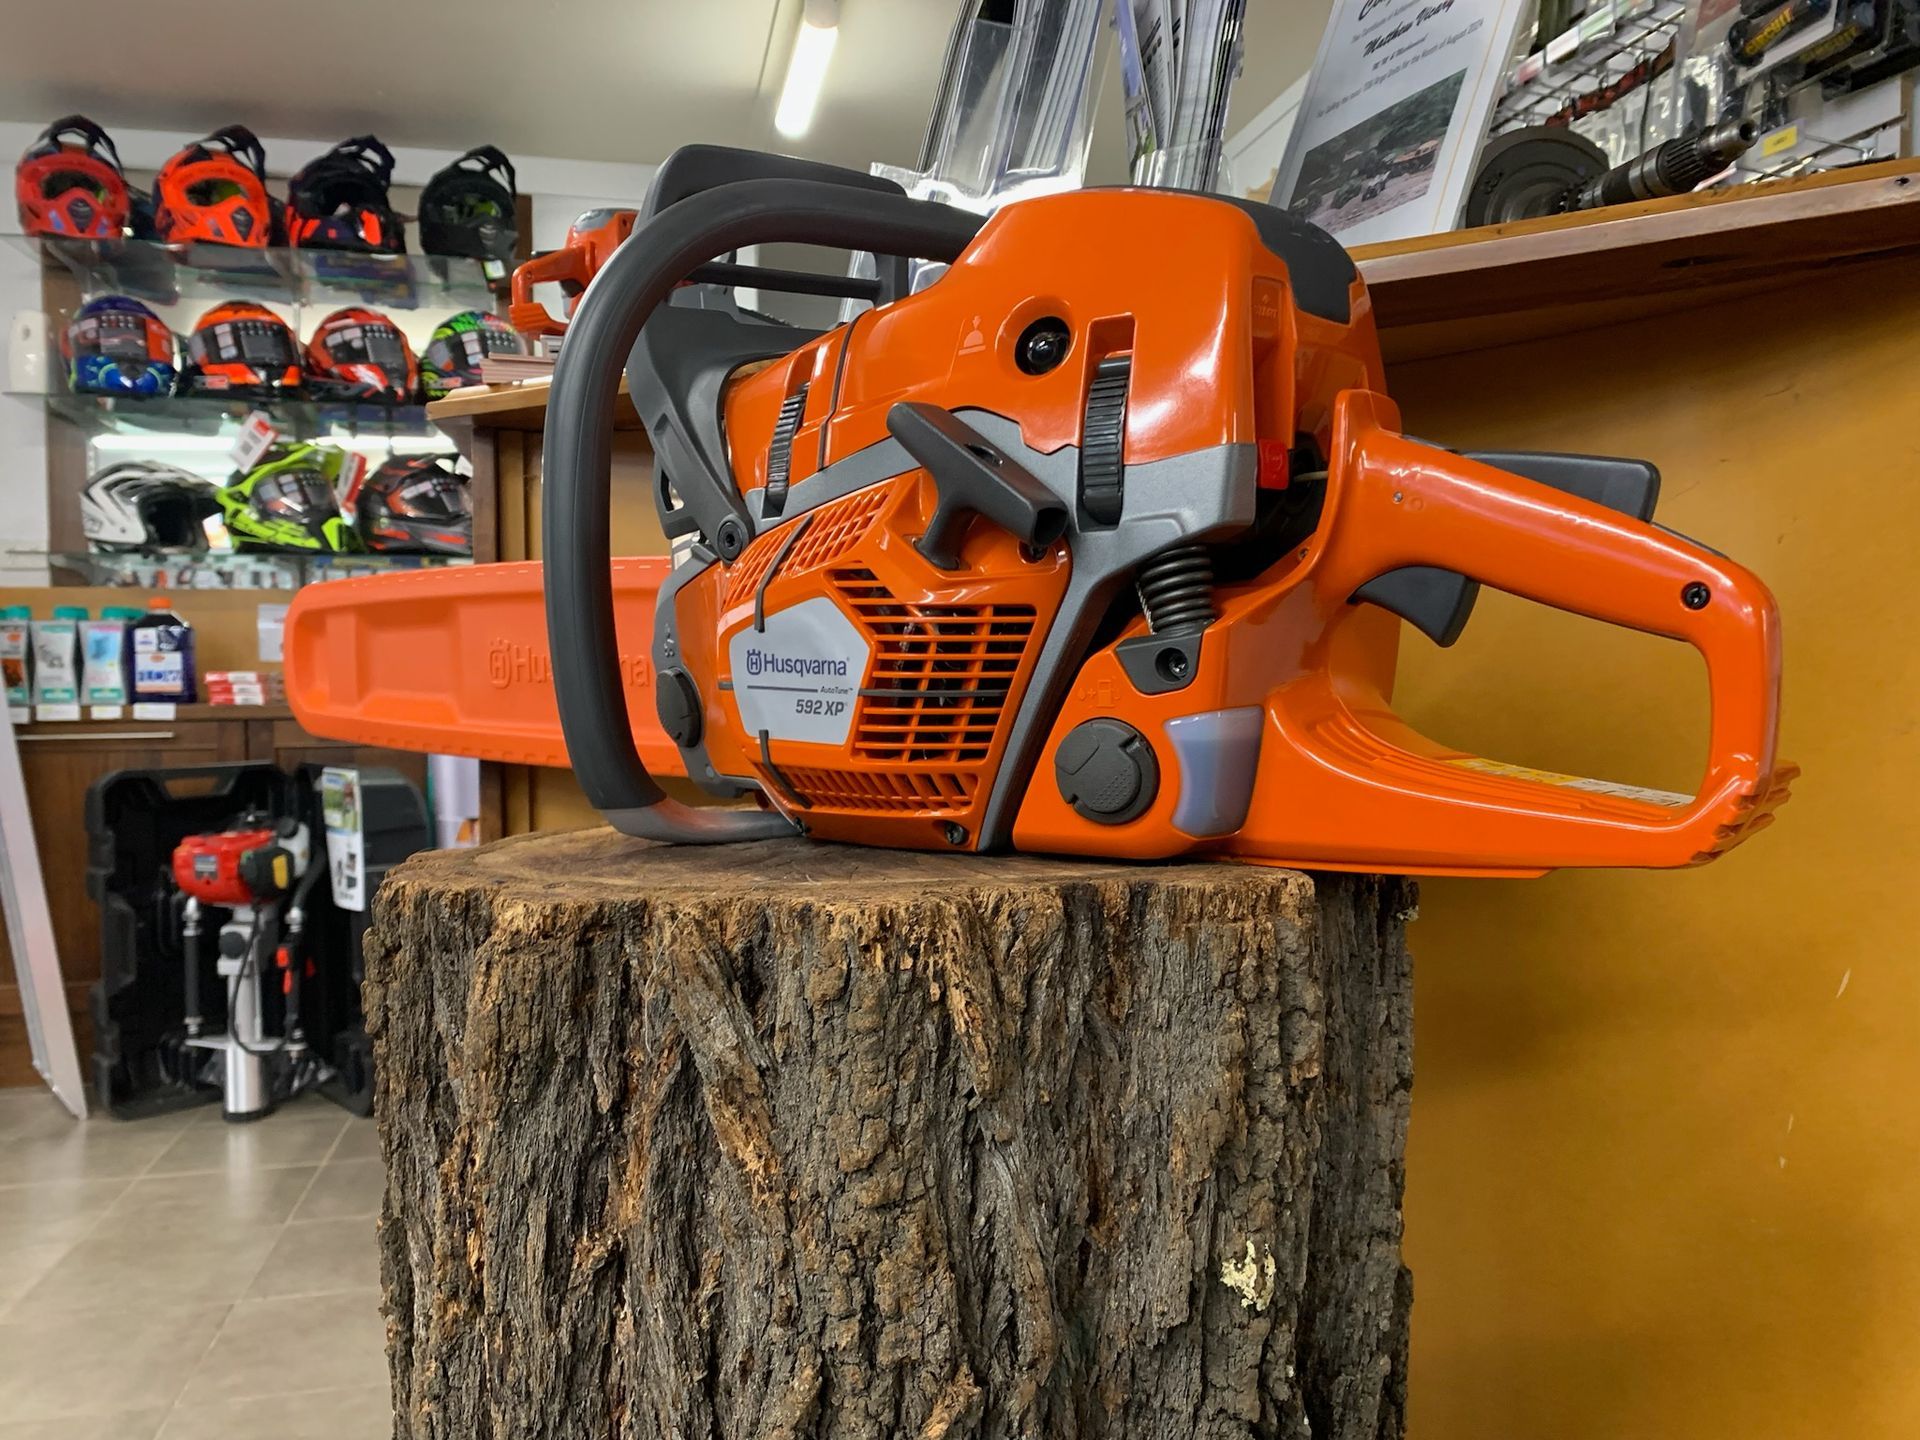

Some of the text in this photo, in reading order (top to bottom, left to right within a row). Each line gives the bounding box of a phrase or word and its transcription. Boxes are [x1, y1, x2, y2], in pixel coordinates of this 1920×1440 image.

[763, 653, 847, 678] Husqvarna
[795, 699, 845, 716] 592 XP
